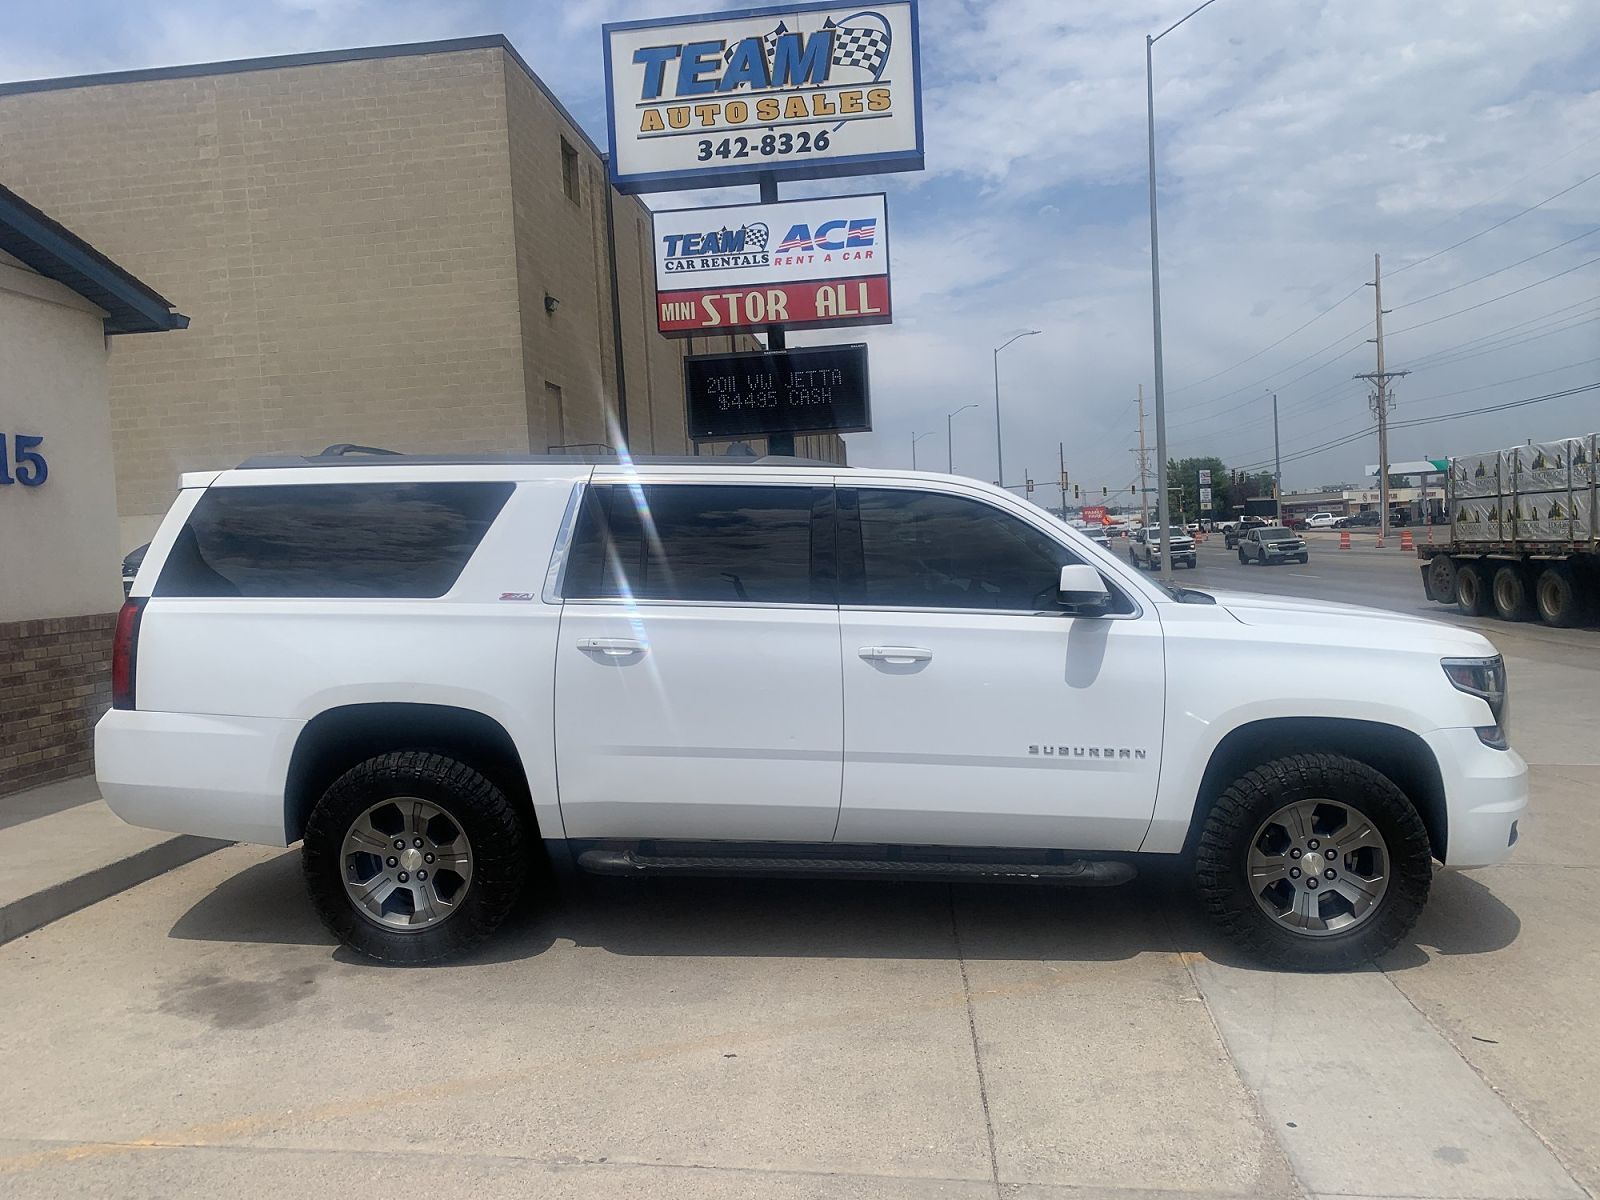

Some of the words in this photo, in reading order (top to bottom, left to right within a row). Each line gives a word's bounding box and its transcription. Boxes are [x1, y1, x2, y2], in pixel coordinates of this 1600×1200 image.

[633, 29, 837, 101] TEAM
[640, 101, 749, 132] AUTO
[756, 88, 892, 121] SALES
[697, 129, 830, 161] 342-8326
[662, 229, 746, 257] TEAM
[775, 218, 877, 254] ACE
[665, 258, 696, 271] CAR
[701, 254, 770, 269] RENTALS
[774, 255, 814, 266] RENT
[824, 253, 832, 262] A
[843, 250, 874, 261] CAR
[661, 301, 696, 322] MINI
[701, 289, 789, 326] STOR
[815, 282, 881, 317] ALL
[707, 376, 736, 394] 2011
[784, 368, 842, 388] JETTA
[789, 387, 832, 406] CASH
[1028, 745, 1146, 759] SUBURBAN
